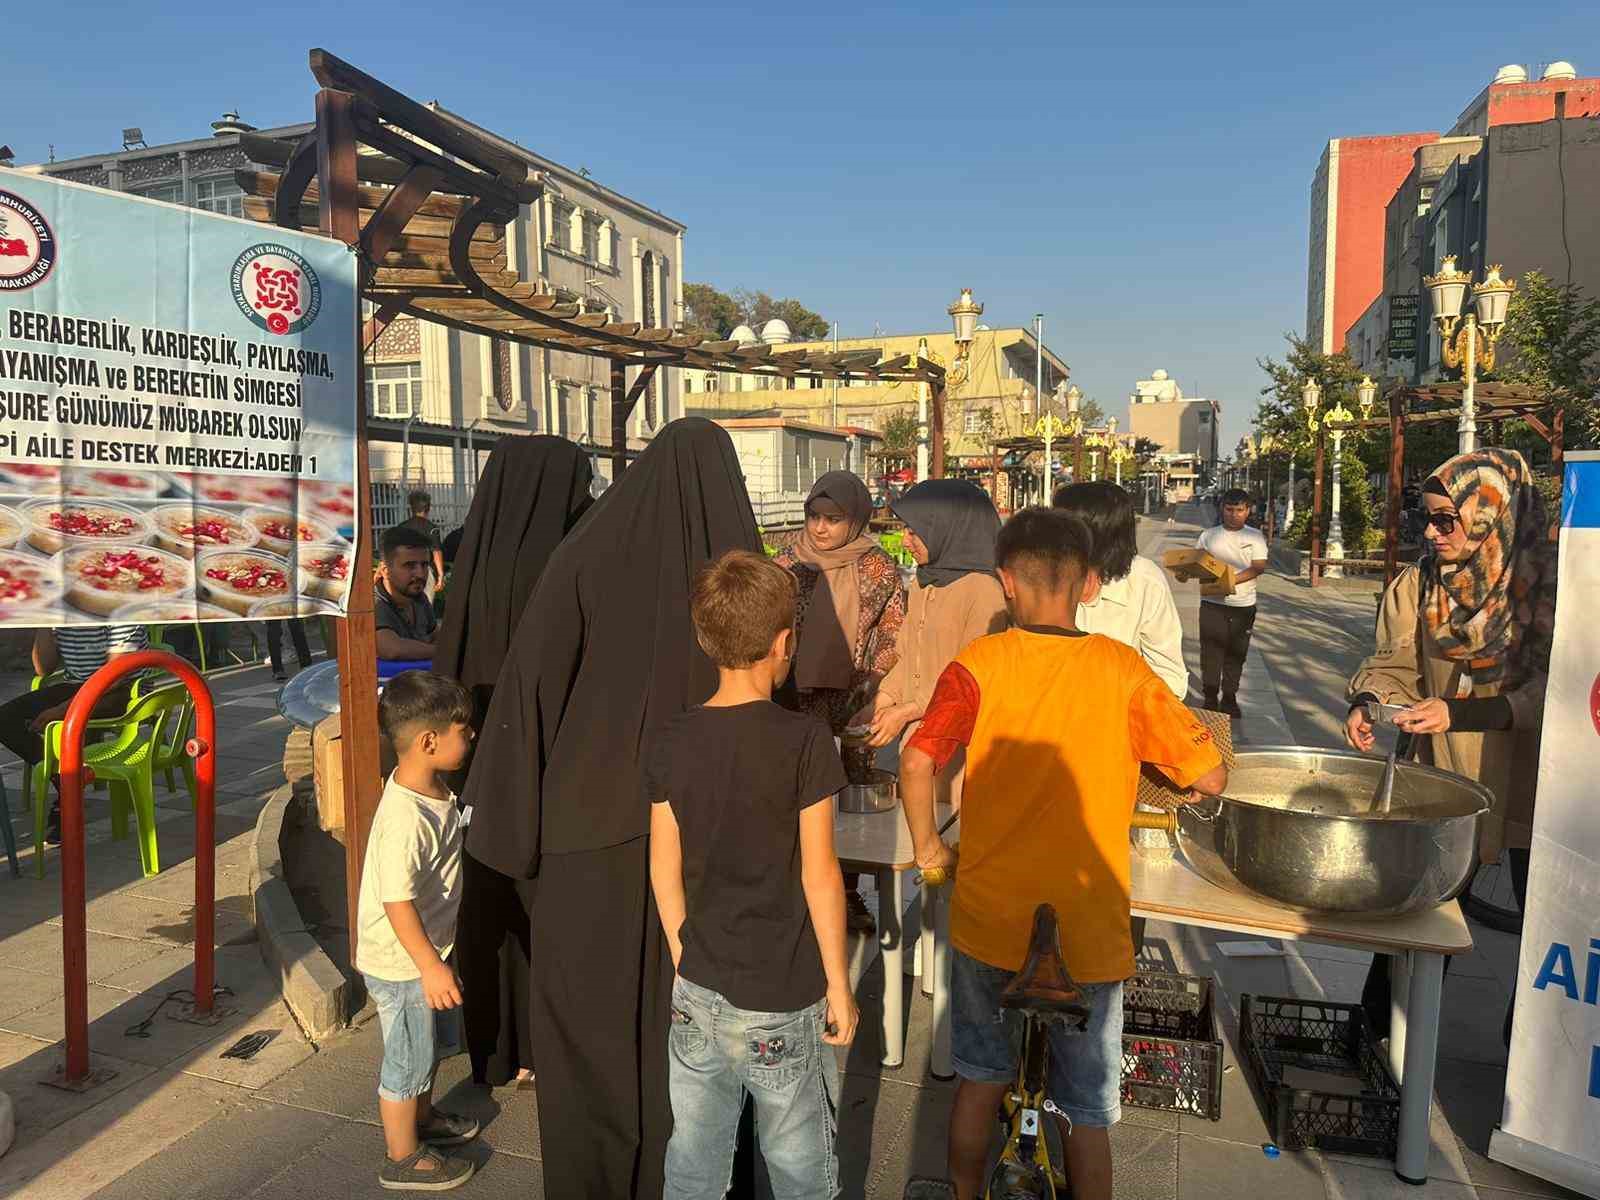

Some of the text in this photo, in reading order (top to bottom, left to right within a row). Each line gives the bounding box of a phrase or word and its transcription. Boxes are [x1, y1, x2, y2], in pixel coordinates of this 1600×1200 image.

[9, 310, 334, 380] BERABERLİK, KARDEŞLİK, PAYLAŞMA,
[105, 367, 127, 390] ve
[134, 365, 228, 400] BEREKETİN
[234, 373, 301, 407] SİMGESİ
[56, 392, 153, 430] GÜNÜMÜZ
[159, 402, 243, 437] MÜBAREK
[249, 414, 301, 442] OLSUN
[26, 433, 74, 459] AİLE
[82, 440, 159, 464] DESTEK
[166, 446, 303, 473] MERKEZİ:ADEM
[309, 456, 317, 474] 1
